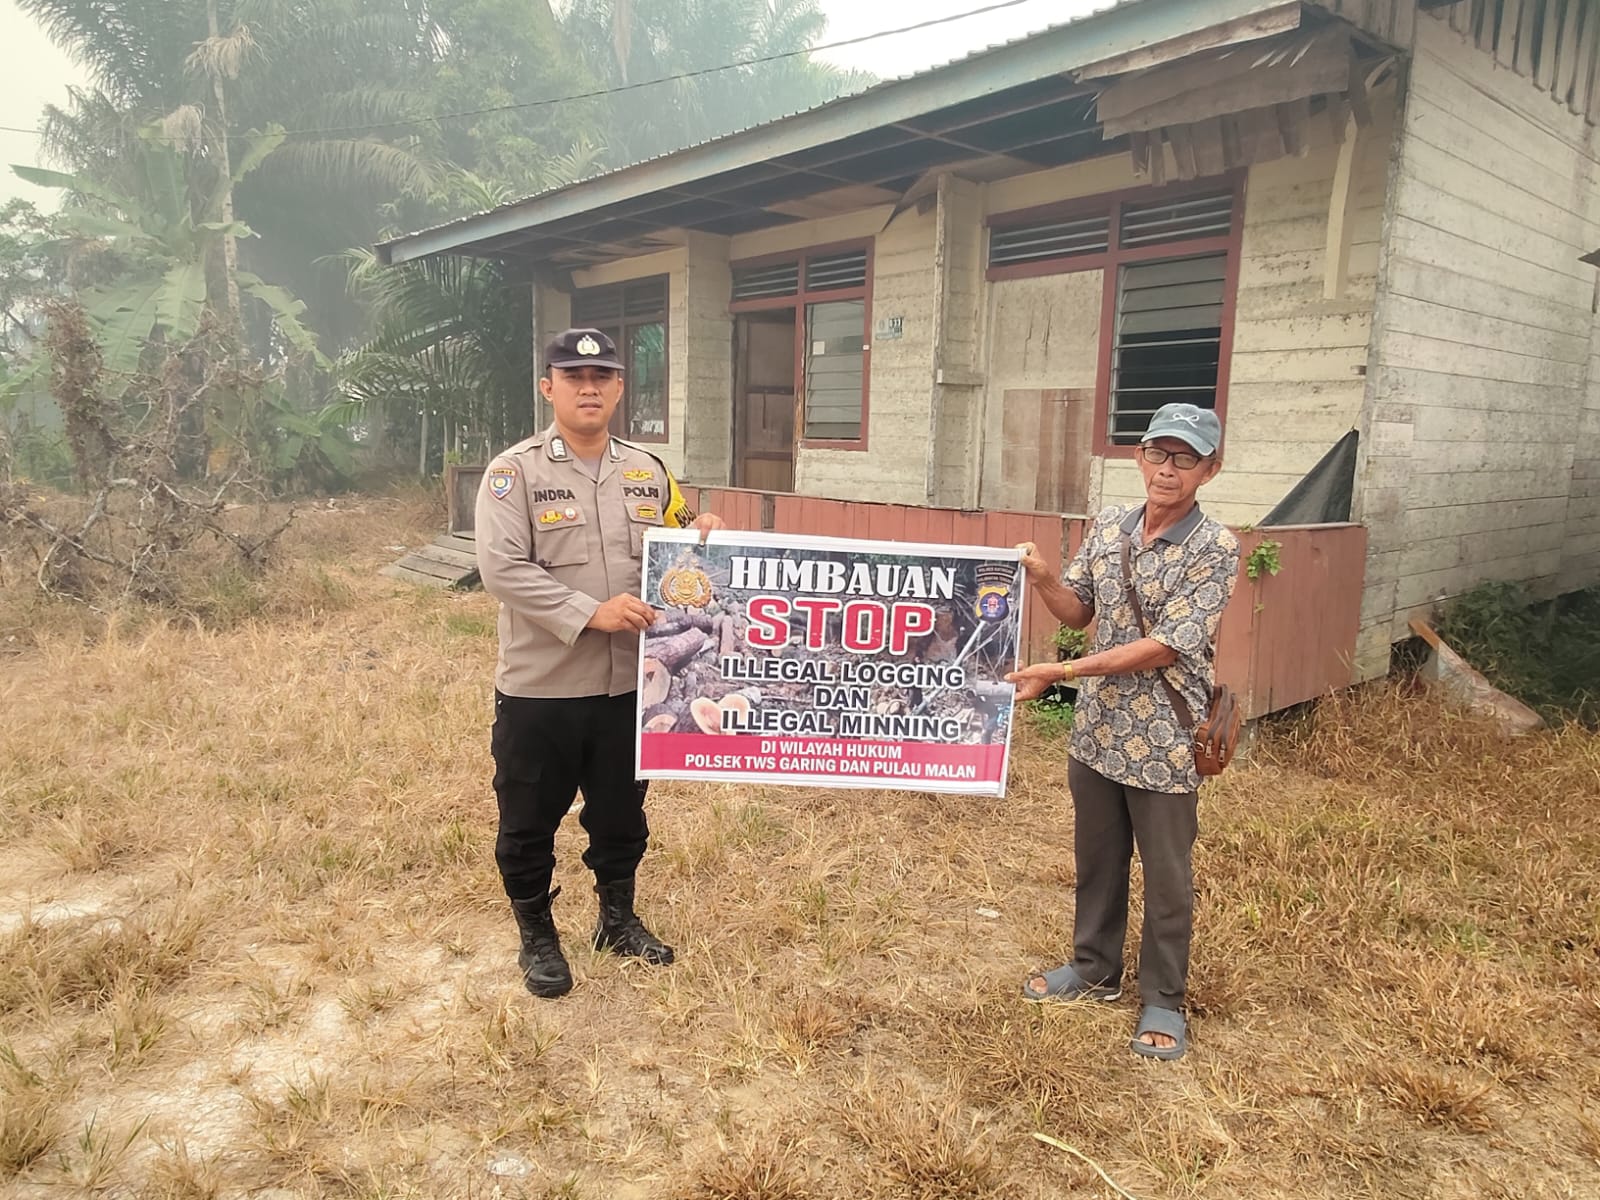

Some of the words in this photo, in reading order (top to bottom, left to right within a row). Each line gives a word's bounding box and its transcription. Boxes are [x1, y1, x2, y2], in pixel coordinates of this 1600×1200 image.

[533, 489, 576, 502] INDRA
[623, 486, 659, 499] POLRI
[729, 556, 957, 599] HIMBAUAN
[747, 596, 936, 655] STOP
[721, 657, 833, 681] ILLEGAL
[842, 663, 964, 687] LOGGING
[815, 687, 869, 709] DAN
[721, 710, 833, 734] ILLEGAL
[841, 715, 960, 739] MINNING
[761, 740, 776, 754] DI
[780, 741, 842, 756] WILAYAH
[846, 743, 902, 759] HUKUM
[685, 753, 742, 769] POLSEK
[744, 755, 776, 770] TWS
[779, 757, 836, 772] GARING
[839, 759, 870, 774] DAN
[873, 761, 921, 776] PULAU
[924, 763, 976, 778] MALAN
